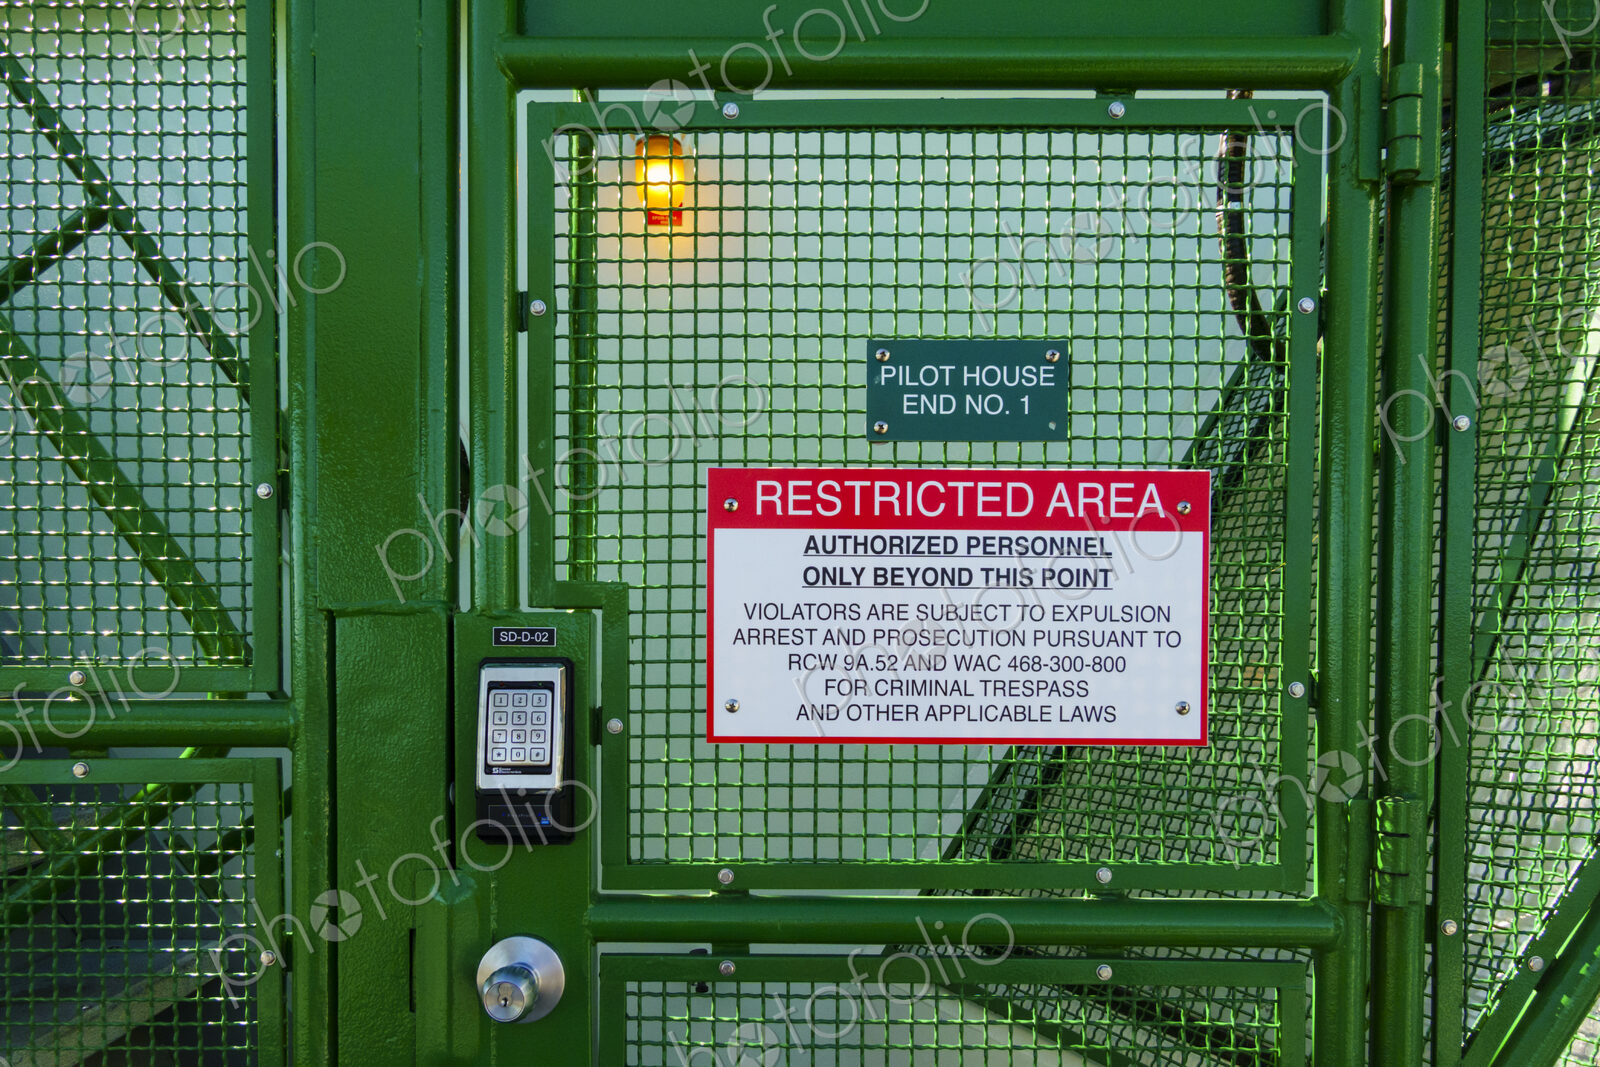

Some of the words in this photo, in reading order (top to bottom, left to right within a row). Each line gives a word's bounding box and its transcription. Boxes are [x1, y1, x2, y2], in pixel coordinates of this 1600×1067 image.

[880, 364, 956, 387] PILOT
[963, 365, 1056, 387] HOUSE
[903, 393, 957, 415] END
[965, 393, 1010, 415] NO.
[1020, 394, 1030, 415] 1
[755, 479, 1034, 517] RESTRICTED
[1045, 482, 1166, 519] AREA
[803, 534, 959, 556] AUTHORIZED
[966, 535, 1113, 557] PERSONNEL
[802, 566, 866, 588] ONLY
[873, 566, 973, 587] BEYOND
[980, 567, 1034, 588] THIS
[1042, 567, 1113, 589] POINT
[743, 602, 861, 621] VIOLATORS
[866, 603, 909, 621] ARE
[916, 603, 1012, 622] SUBJECT
[1016, 604, 1045, 622] TO
[1052, 604, 1171, 623] EXPULSION
[498, 631, 549, 643] SD-D-02
[732, 628, 818, 646] ARREST
[822, 628, 866, 646] AND
[873, 628, 1026, 647] PROSECUTION
[1033, 629, 1148, 648] PURSUANT
[1153, 630, 1182, 649] TO
[788, 653, 838, 671] RCW
[843, 654, 898, 672] 9A.52
[903, 654, 947, 672] AND
[953, 654, 1001, 672] WAC
[1007, 655, 1126, 673] 468-300-800
[825, 678, 868, 697] FOR
[874, 678, 975, 697] CRIMINAL
[979, 679, 1089, 698] TRESPASS
[796, 703, 840, 721] AND
[846, 703, 919, 722] OTHER
[924, 704, 1052, 722] APPLICABLE
[1059, 705, 1117, 723] LAWS
